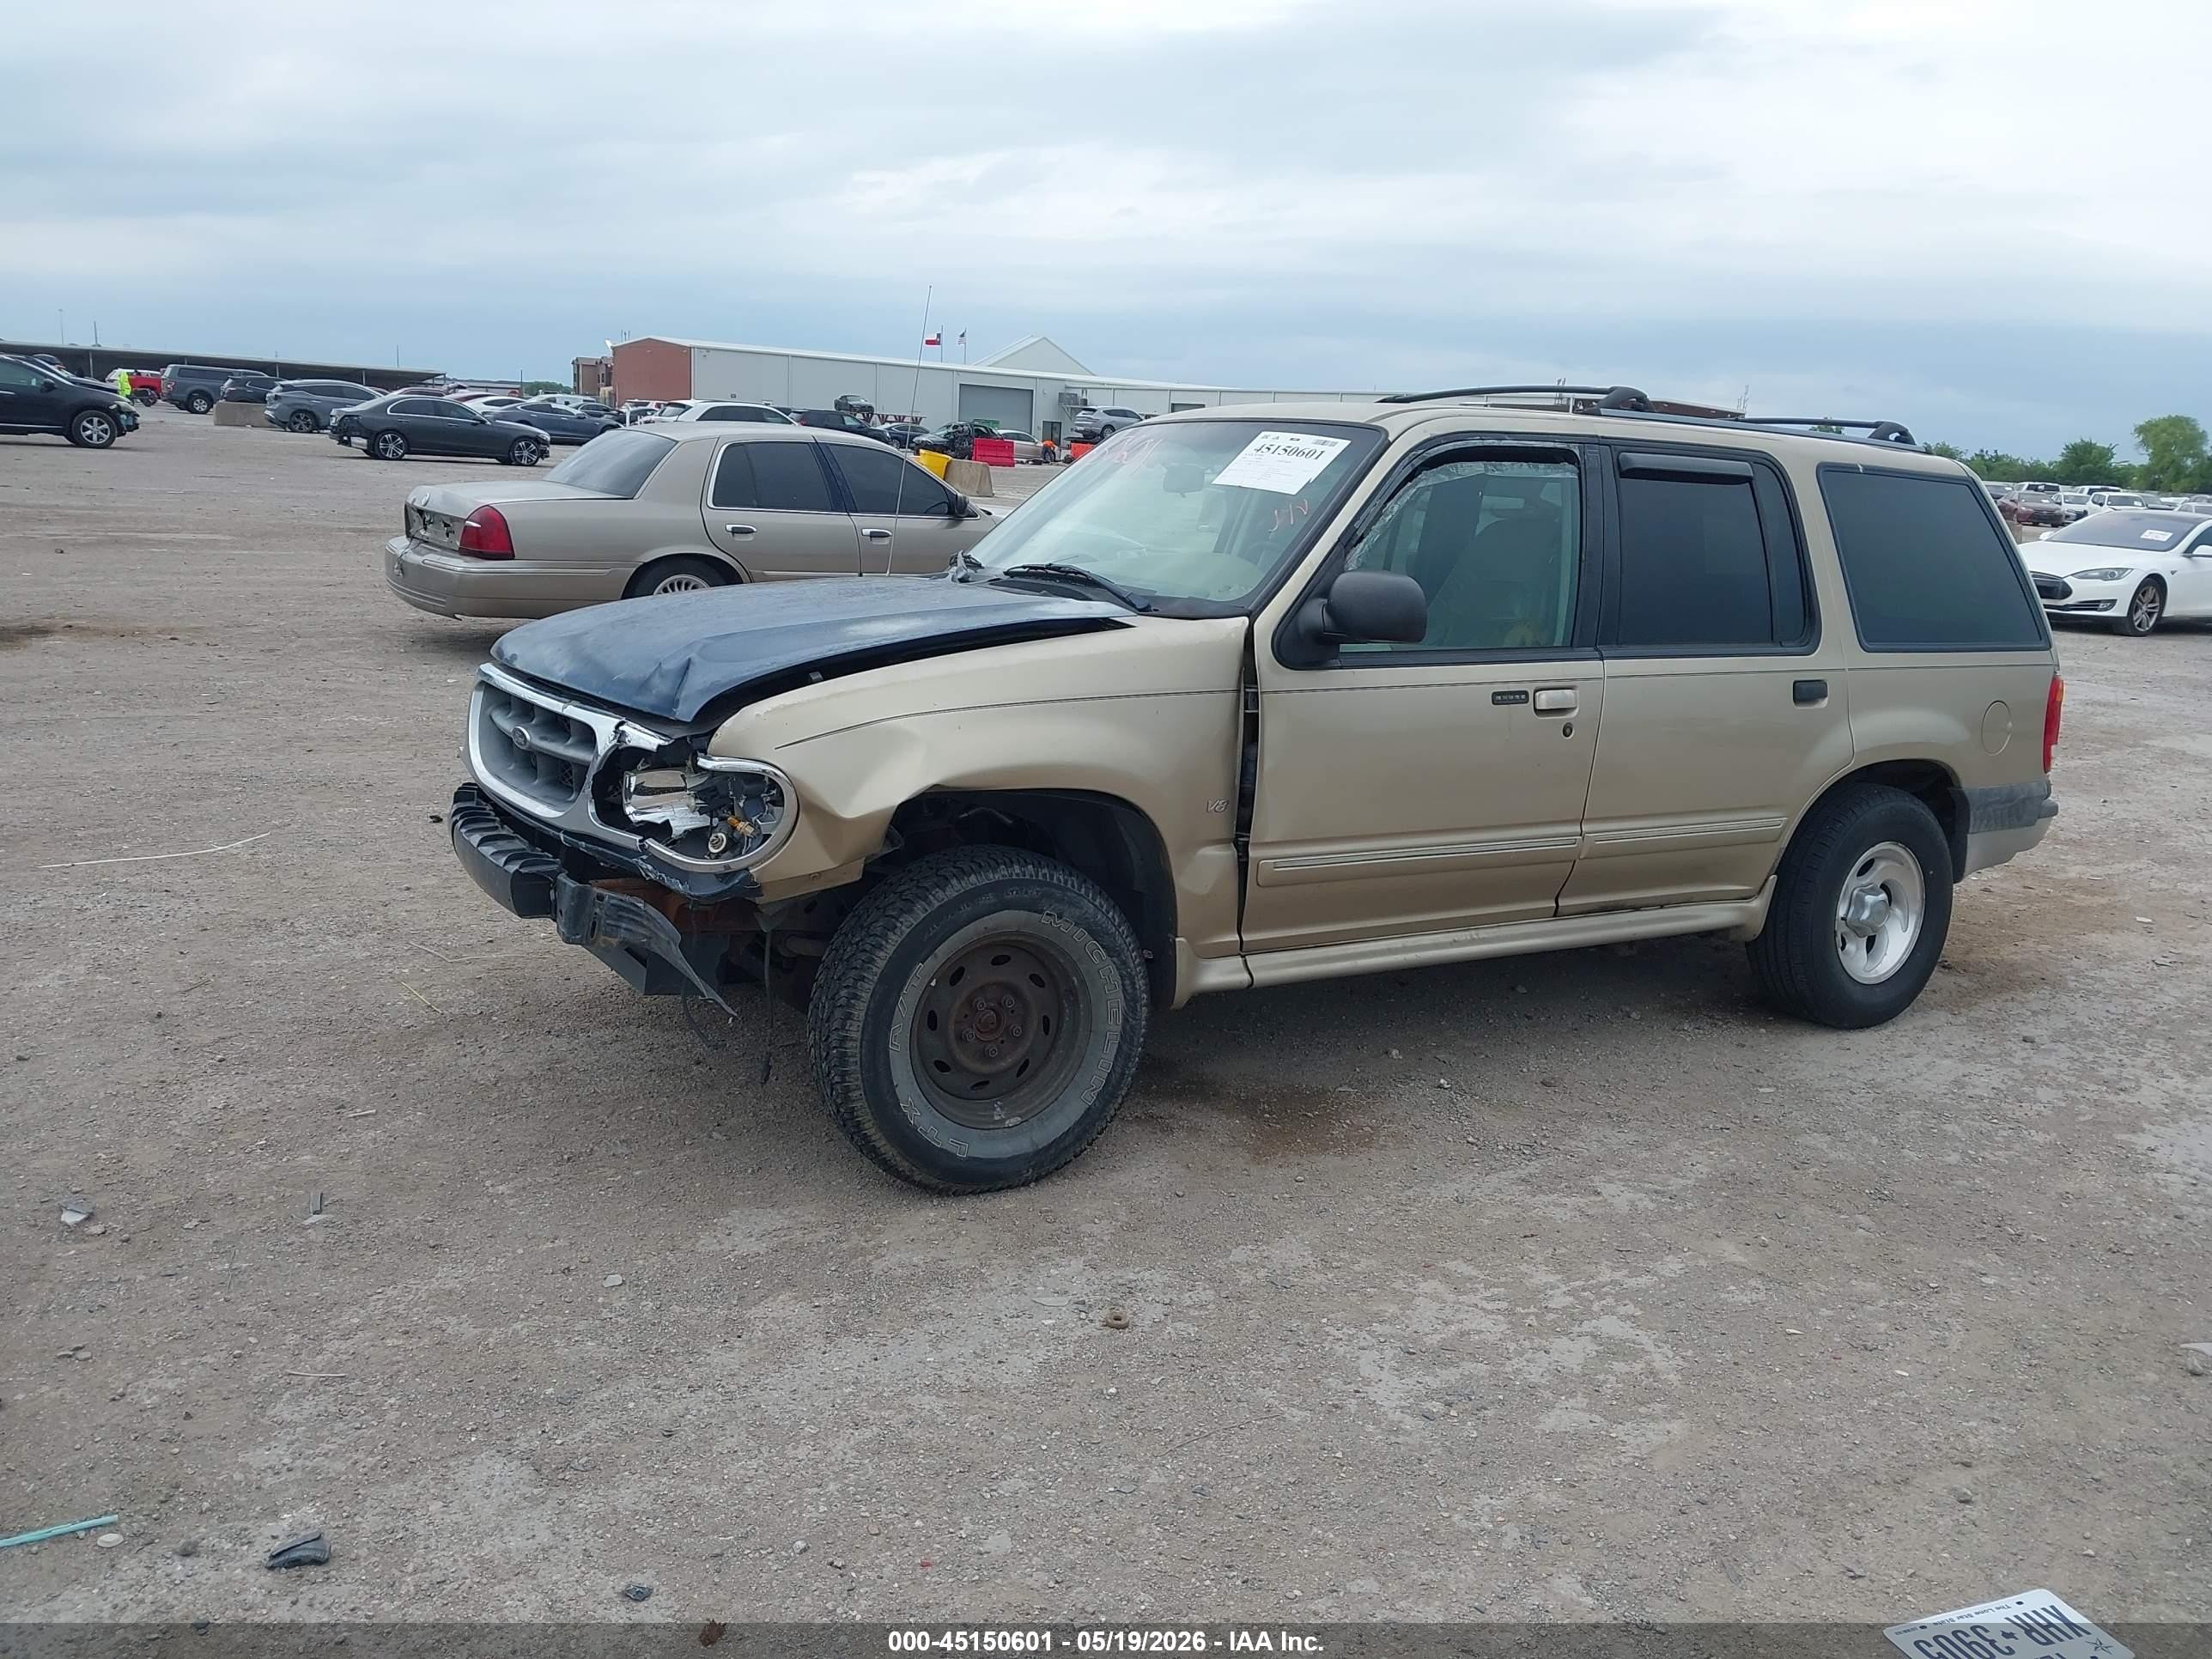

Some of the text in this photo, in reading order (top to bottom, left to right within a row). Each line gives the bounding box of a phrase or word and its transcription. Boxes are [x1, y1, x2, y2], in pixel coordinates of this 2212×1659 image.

[1254, 442, 1326, 460] 45150601
[1040, 910, 1121, 1106] MICHELIN
[900, 1096, 970, 1158] LTX
[1995, 1603, 2012, 1612] The
[2004, 1605, 2093, 1646] XHR
